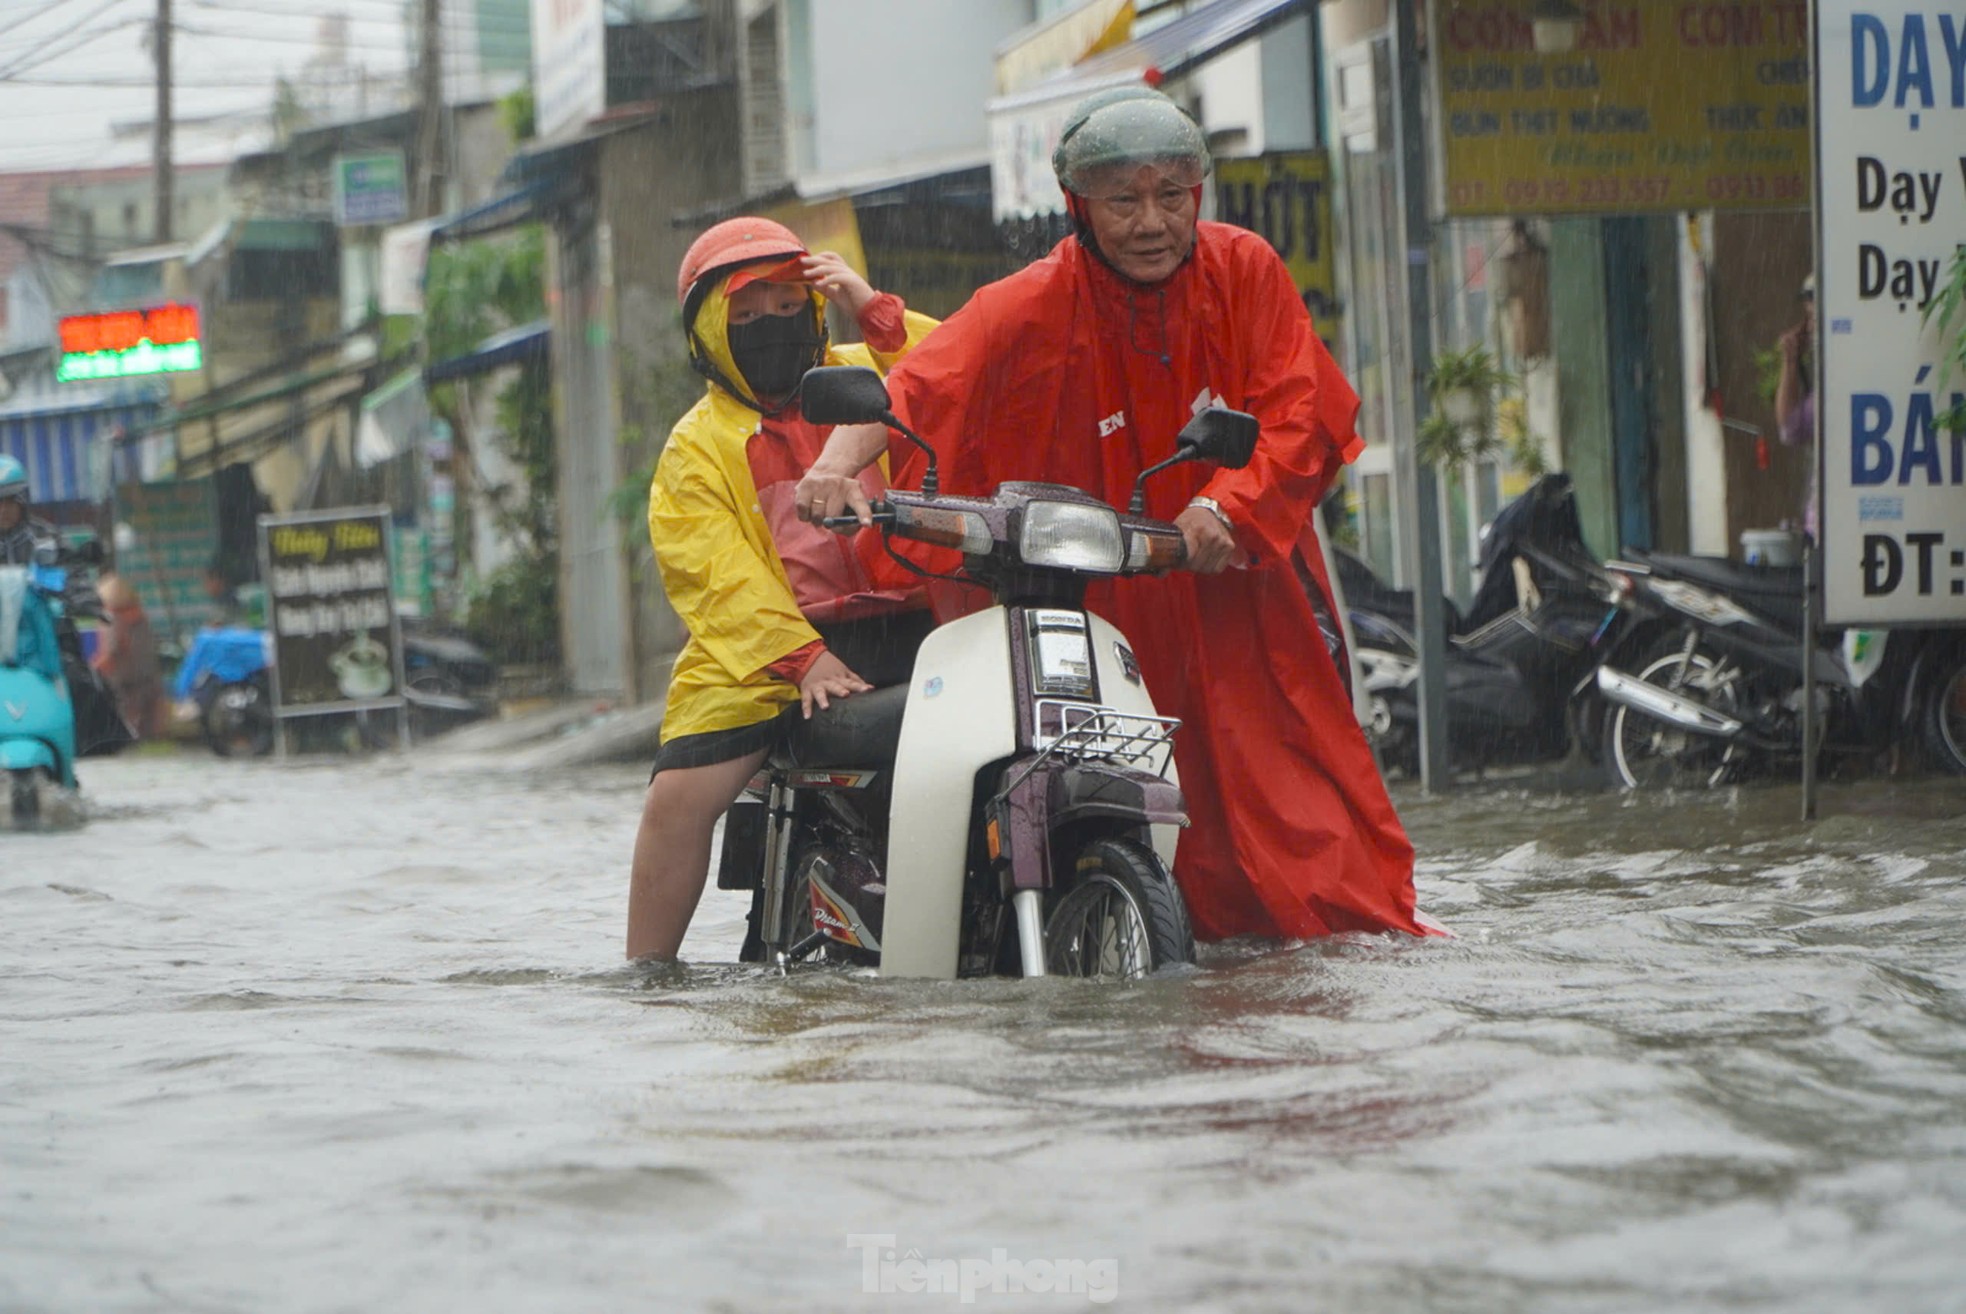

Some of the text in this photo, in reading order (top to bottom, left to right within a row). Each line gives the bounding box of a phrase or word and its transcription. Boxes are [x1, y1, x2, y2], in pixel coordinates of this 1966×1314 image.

[1857, 157, 1942, 224] Dạy
[1858, 244, 1940, 312] Dạy
[1860, 532, 1965, 597] ĐT:
